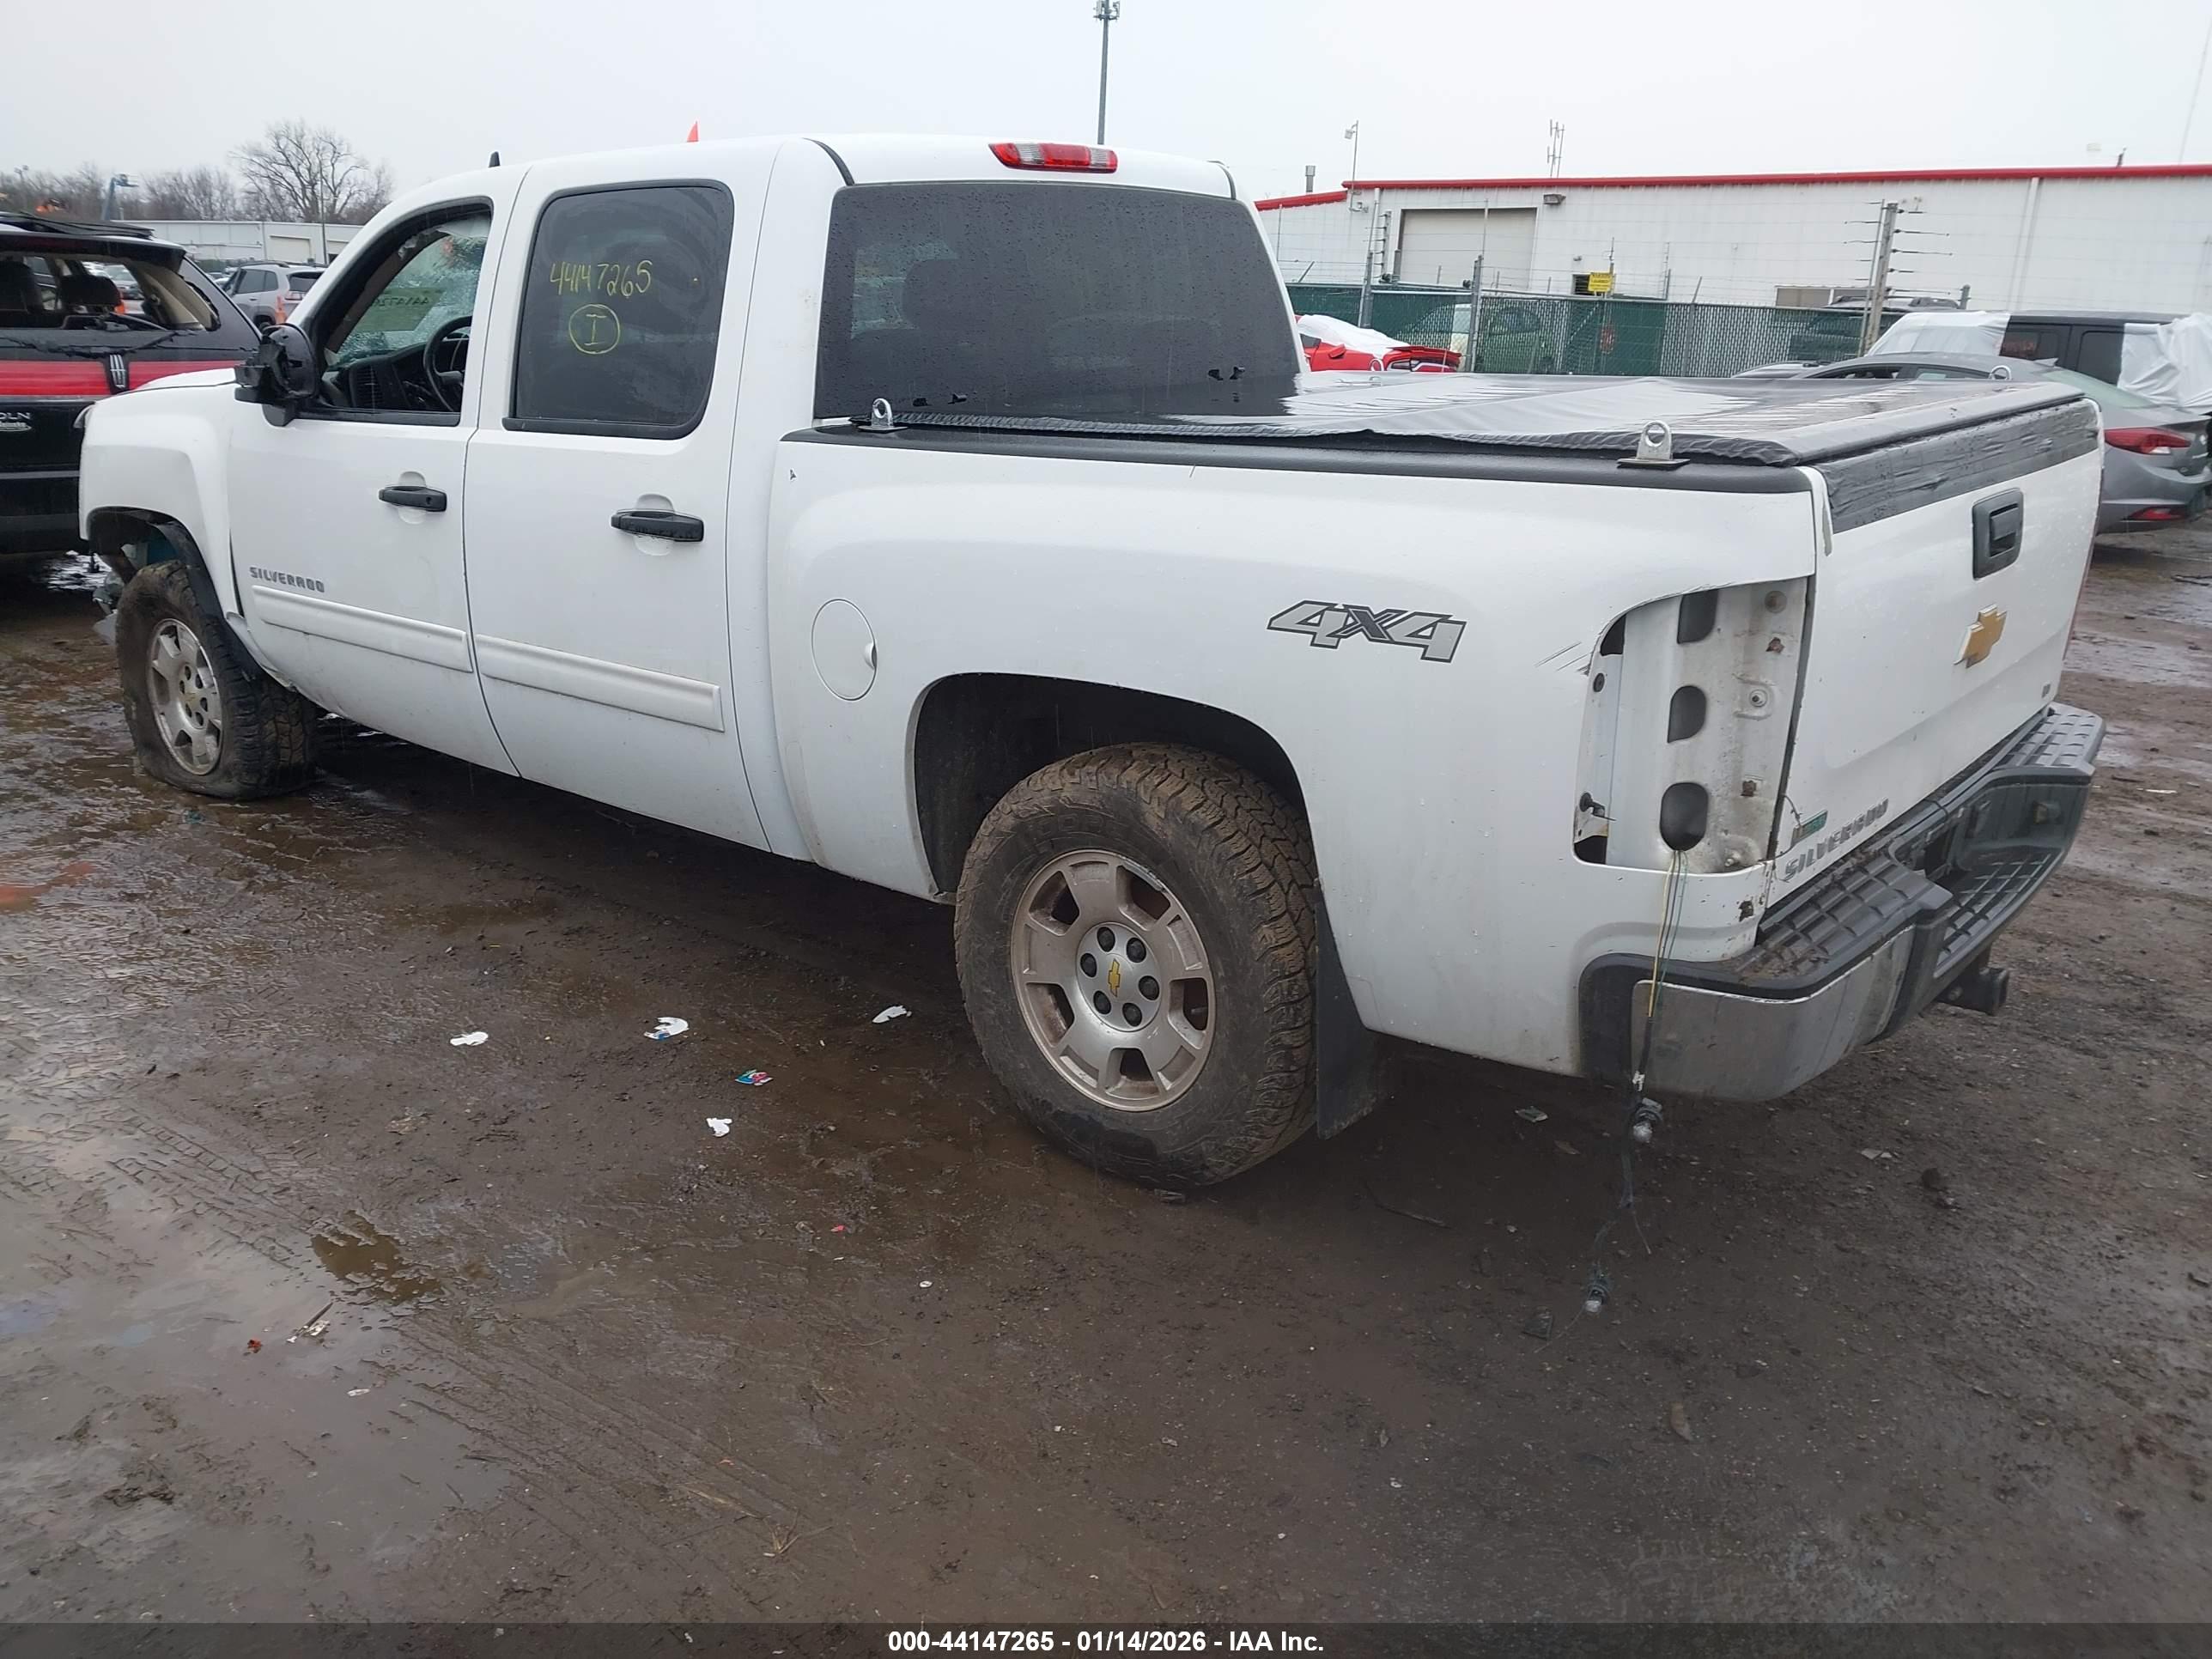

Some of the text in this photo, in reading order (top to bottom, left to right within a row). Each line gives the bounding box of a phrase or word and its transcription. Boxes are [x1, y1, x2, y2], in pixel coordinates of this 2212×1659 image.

[550, 260, 653, 297] 44147265
[249, 566, 325, 593] SILVERADO
[1784, 798, 1889, 881] SILVERADO
